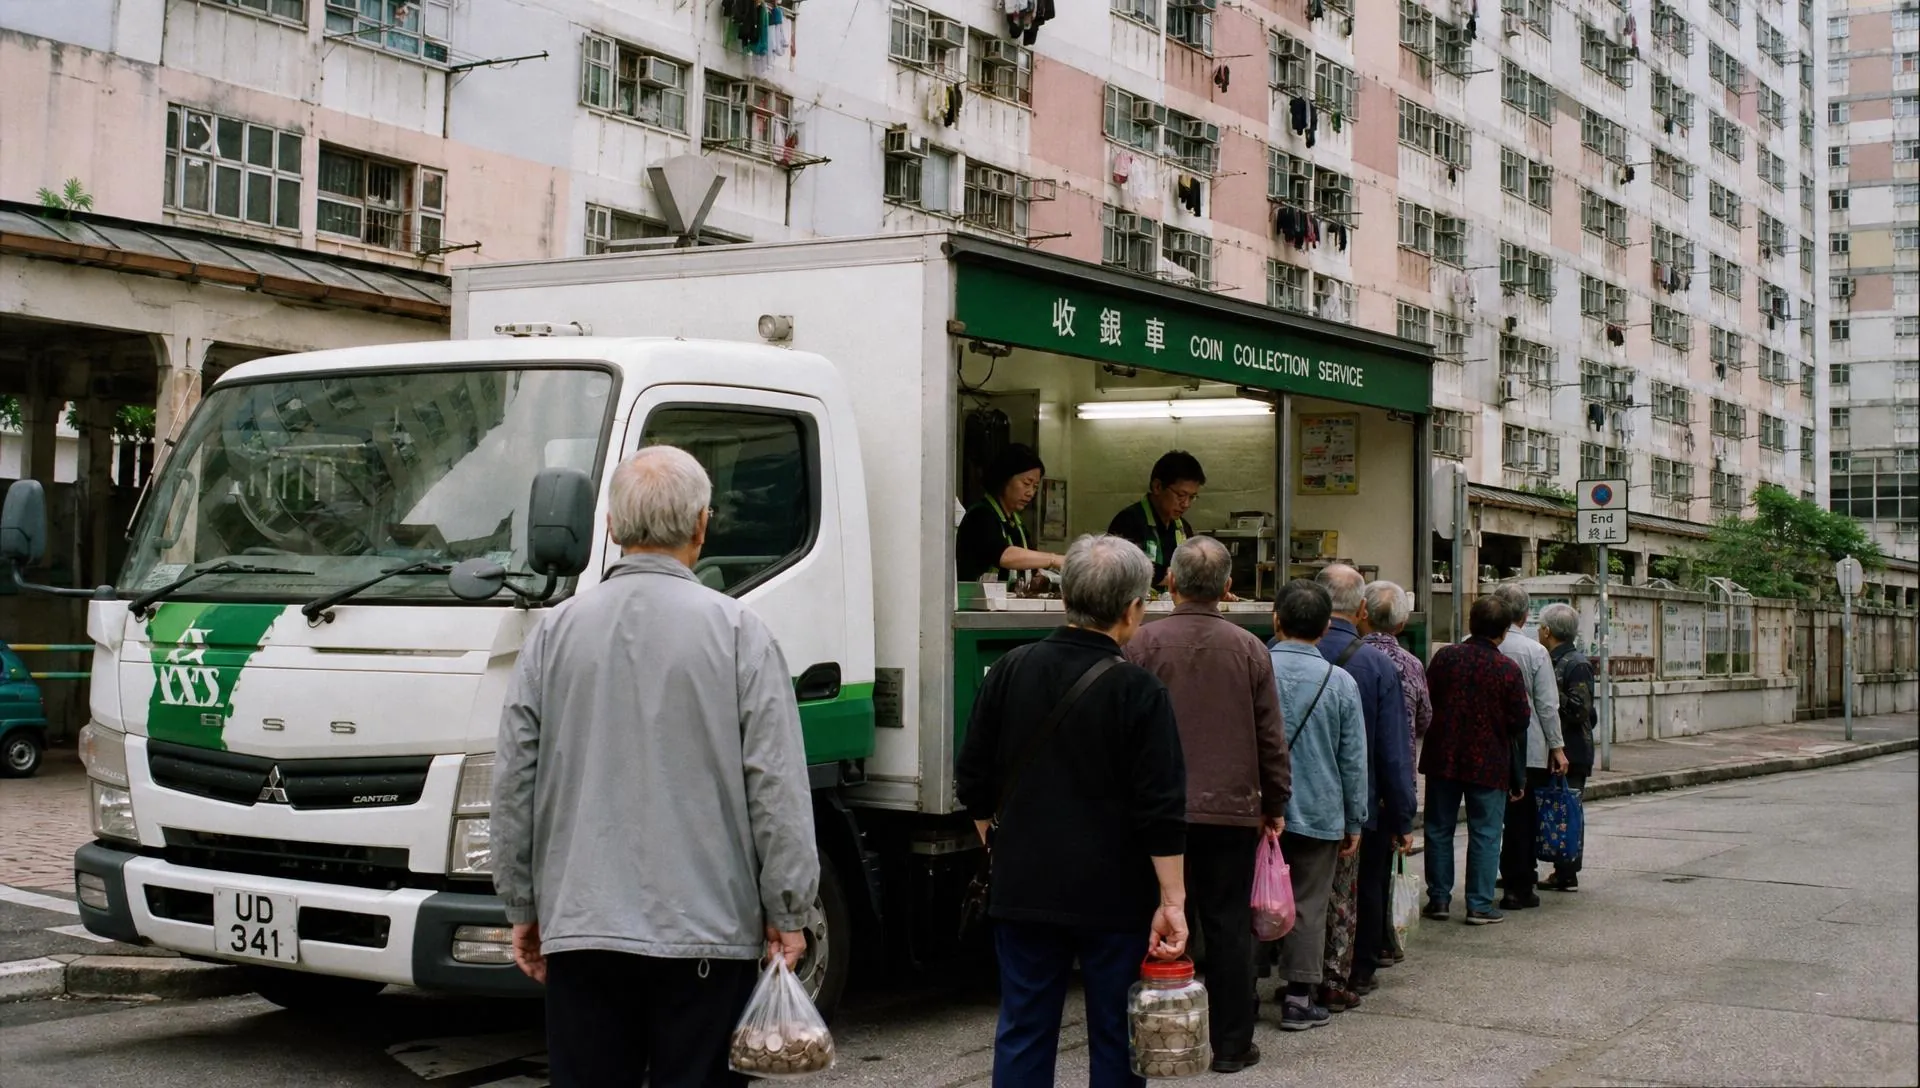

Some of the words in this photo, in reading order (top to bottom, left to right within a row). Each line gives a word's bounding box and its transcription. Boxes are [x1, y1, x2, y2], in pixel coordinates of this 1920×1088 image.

[1052, 297, 1166, 354] 收銀車
[1190, 335, 1223, 362] COIN
[1233, 344, 1309, 377] COLLECTION
[1318, 360, 1363, 387] SERVICE
[1588, 527, 1616, 539] 終止
[1591, 513, 1613, 523] End
[352, 794, 398, 803] CANTER
[236, 893, 273, 924] UD
[231, 924, 278, 958] 341
